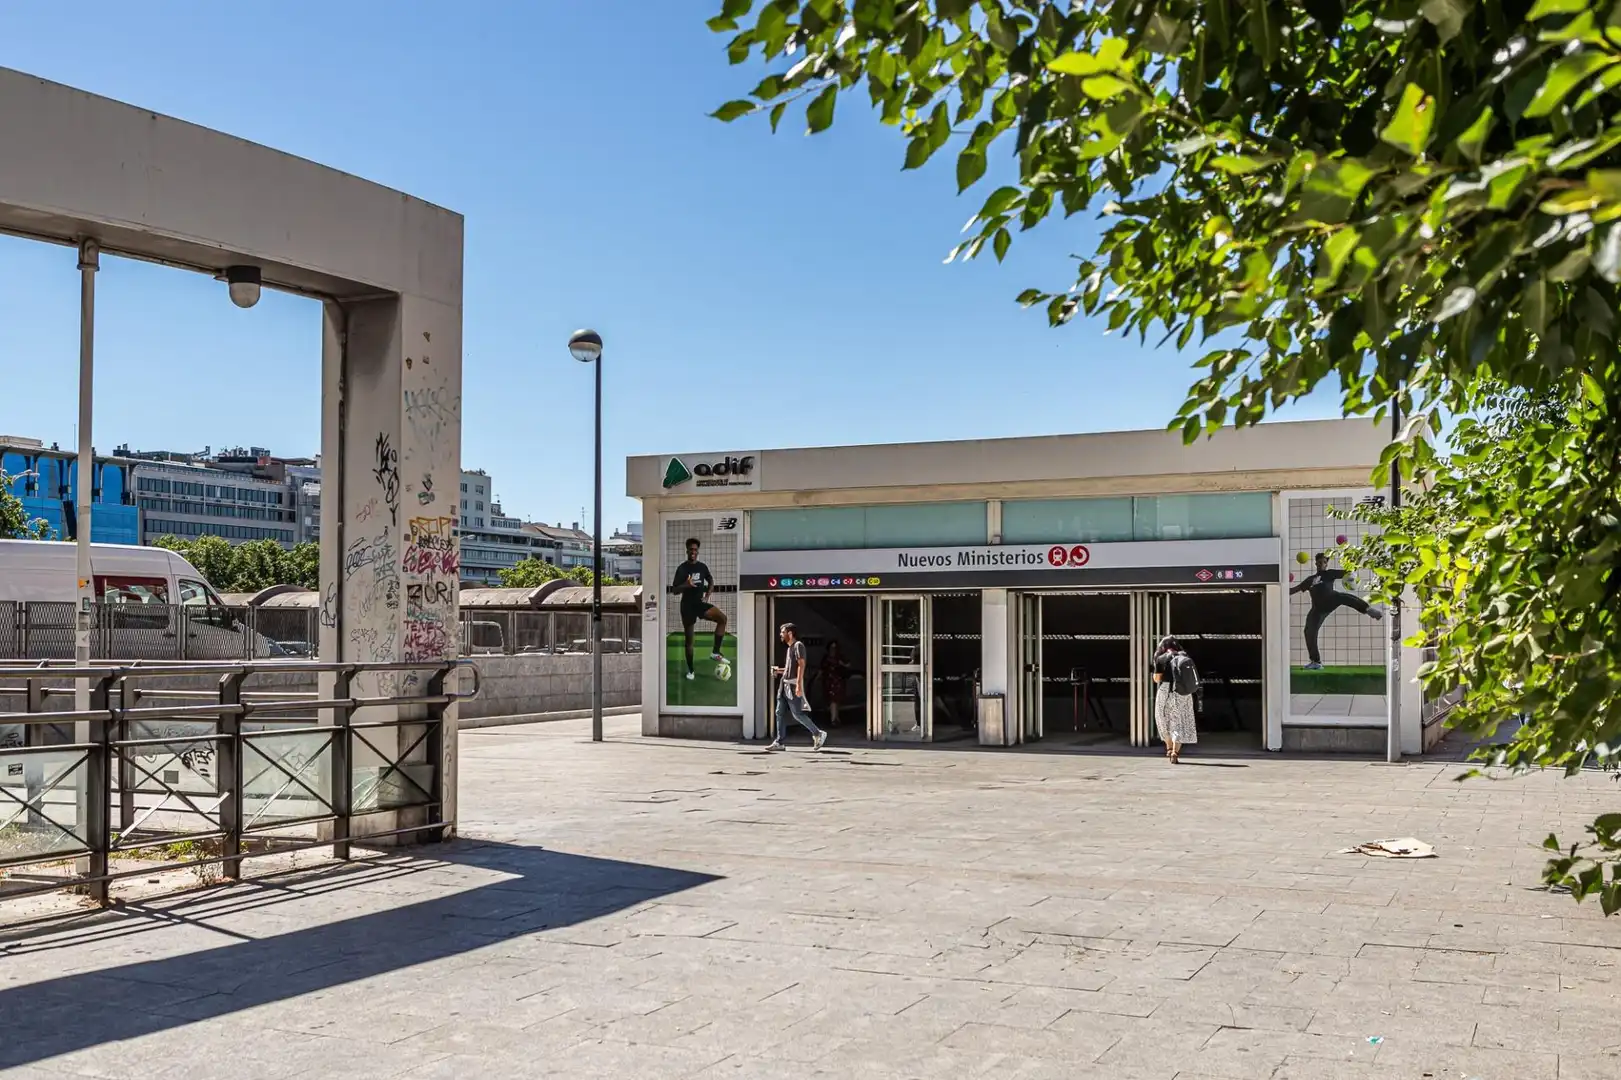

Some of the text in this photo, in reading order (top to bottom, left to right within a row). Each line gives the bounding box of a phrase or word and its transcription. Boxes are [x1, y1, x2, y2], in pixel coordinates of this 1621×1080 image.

[693, 456, 755, 476] adif
[898, 549, 1044, 567] Nuevos Ministerios
